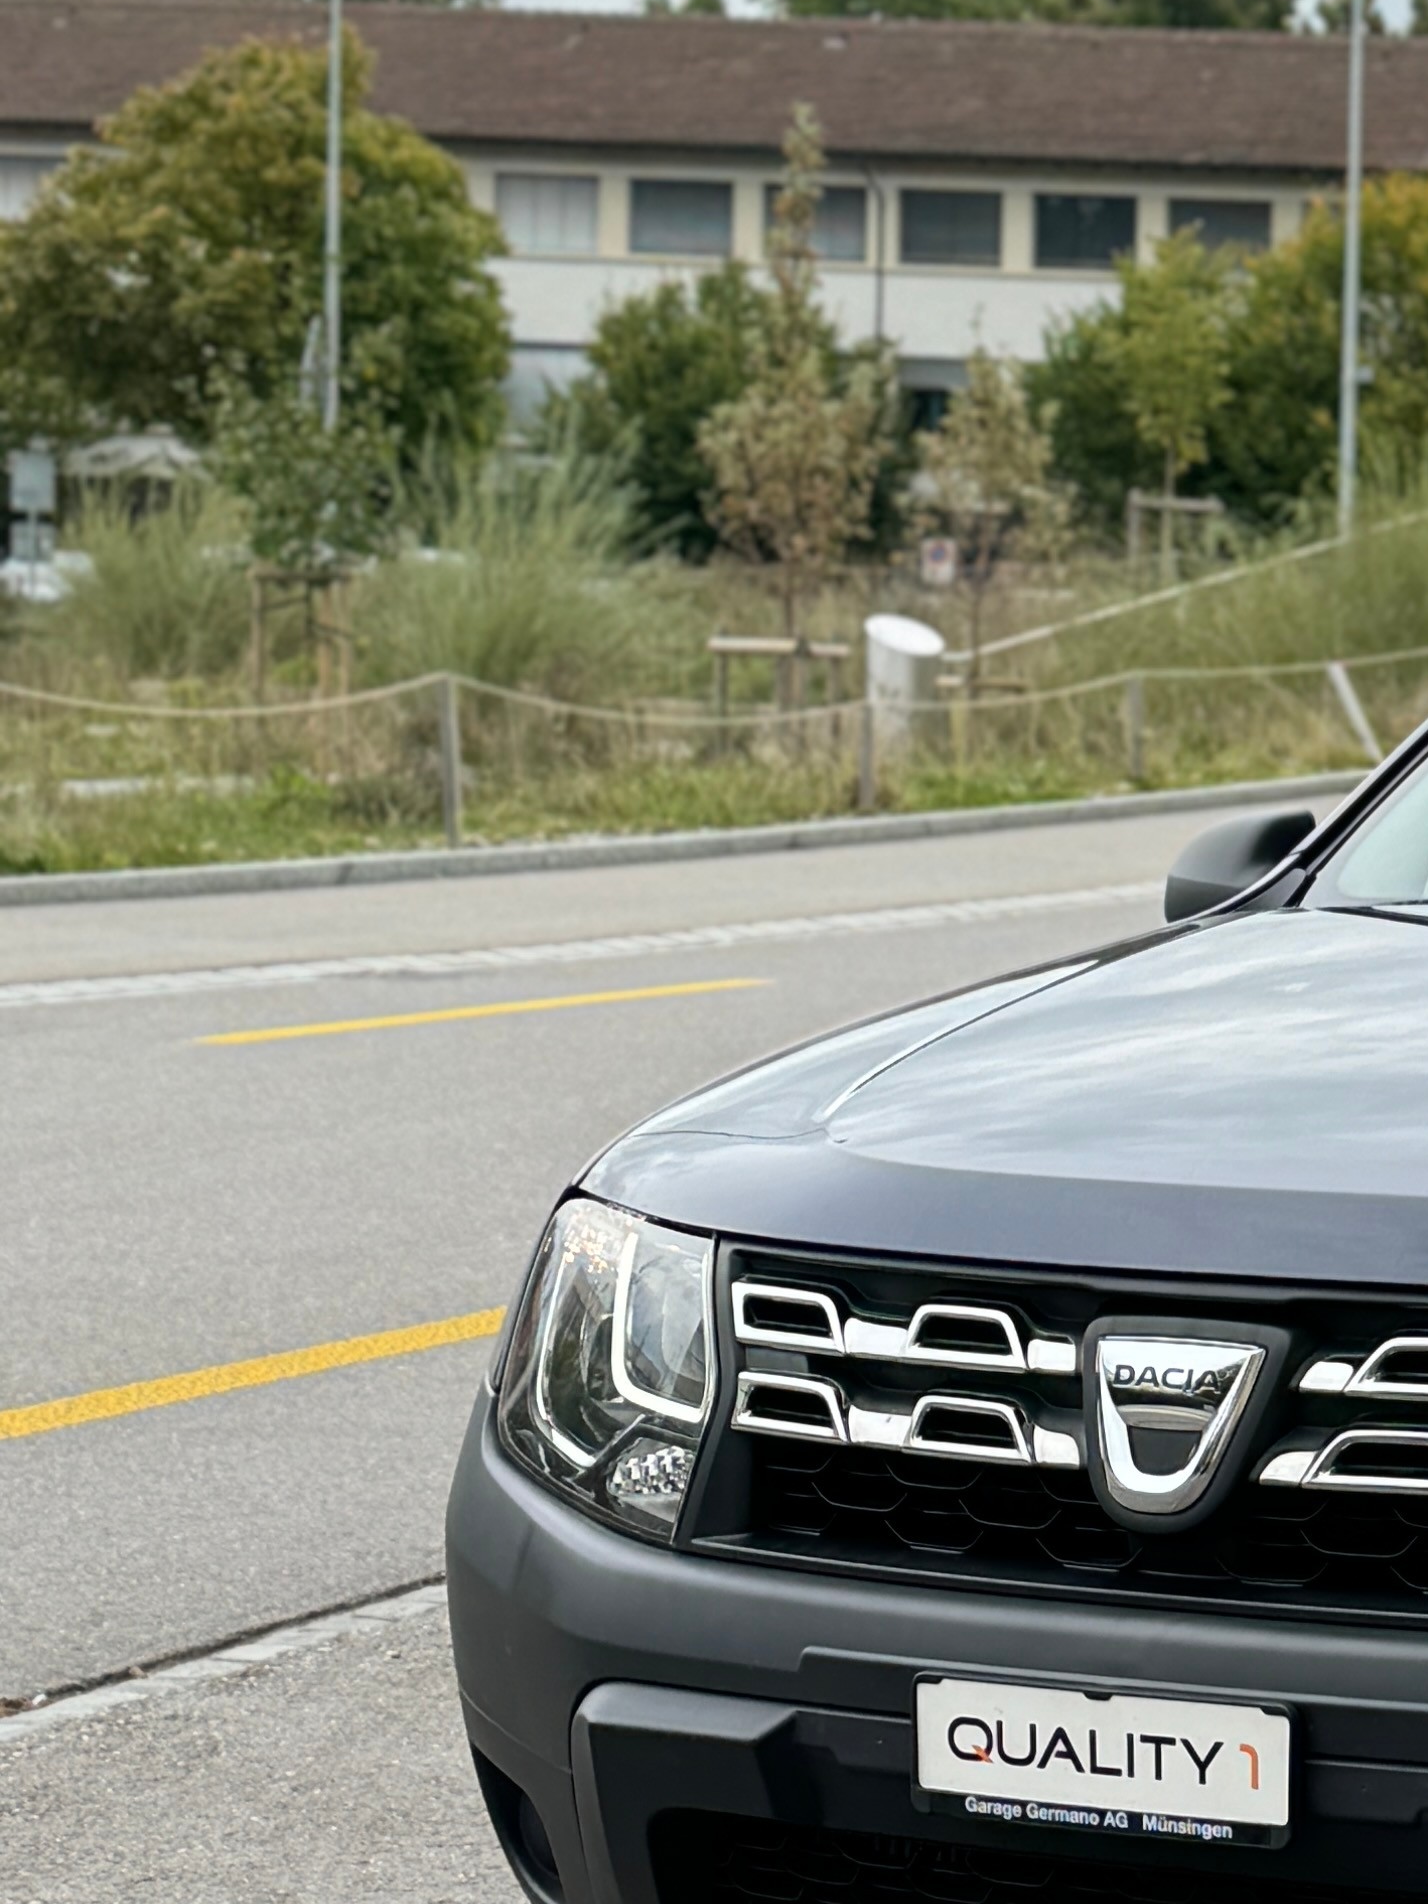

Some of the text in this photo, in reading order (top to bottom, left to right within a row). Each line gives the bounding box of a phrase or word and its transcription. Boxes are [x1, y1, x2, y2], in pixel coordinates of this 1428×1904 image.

[1112, 1363, 1220, 1394] DACIA
[947, 1716, 1259, 1790] QUALITY 1
[965, 1796, 1233, 1840] Garage Germano AG Münsingen
